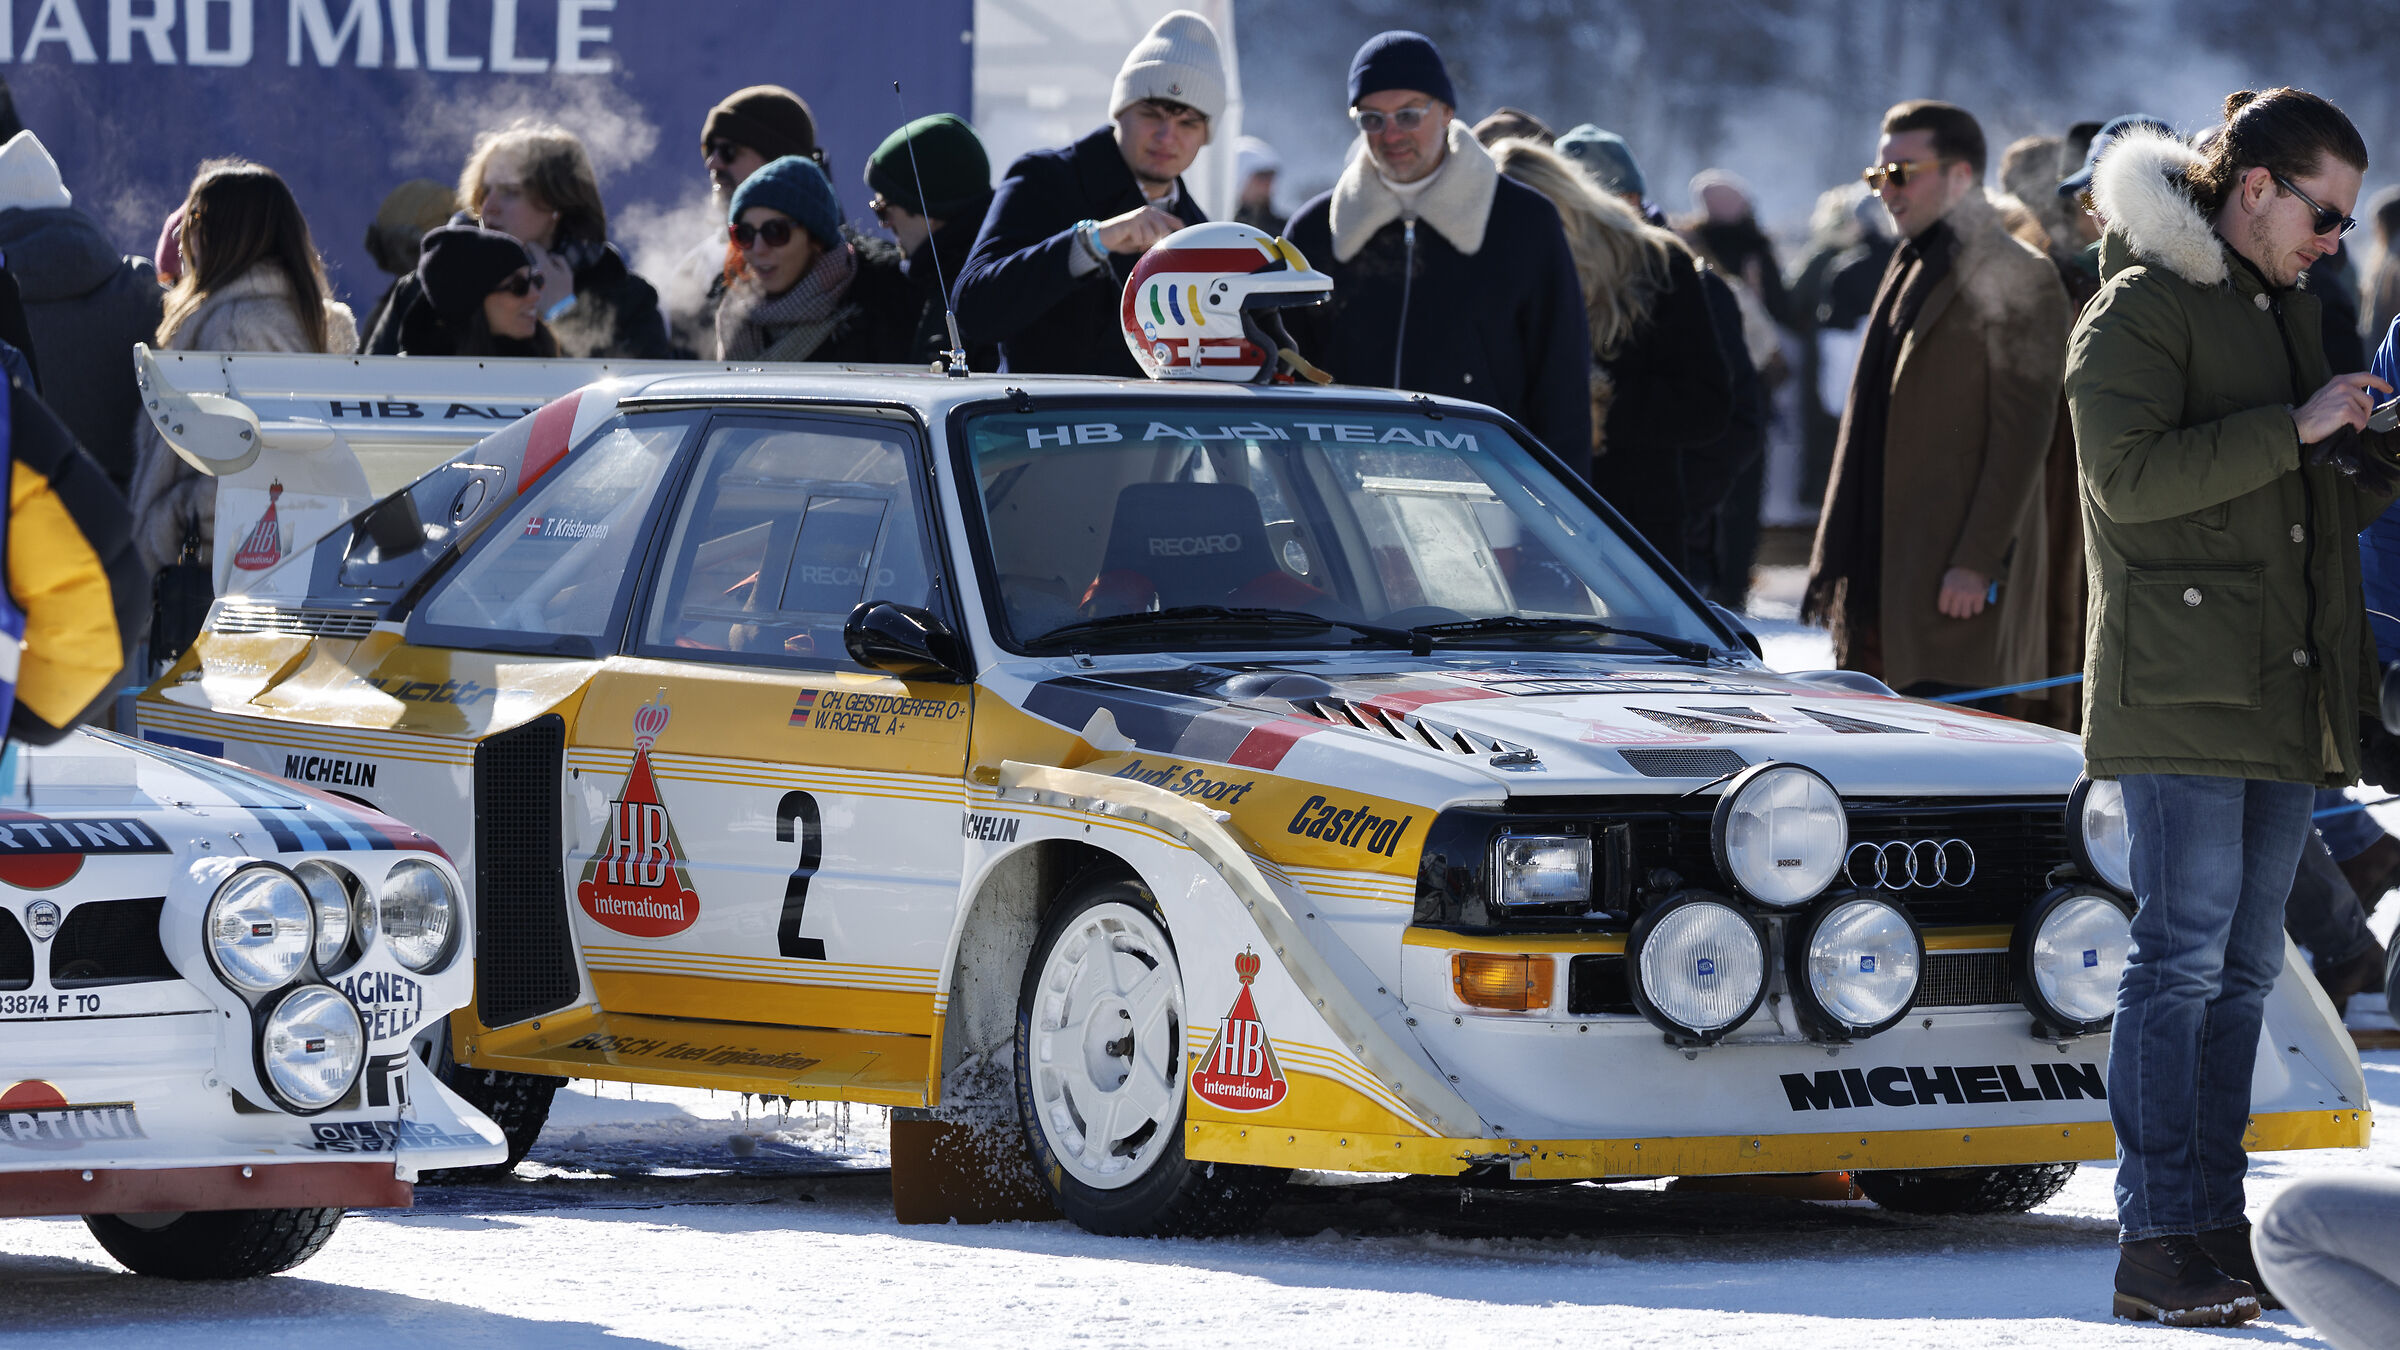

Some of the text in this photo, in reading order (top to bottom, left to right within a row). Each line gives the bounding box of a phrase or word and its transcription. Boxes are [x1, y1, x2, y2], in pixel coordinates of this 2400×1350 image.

[287, 0, 614, 73] MILLE
[329, 401, 424, 418] HB
[1026, 423, 1123, 448] HB
[1292, 422, 1479, 452] TEAM
[247, 520, 278, 553] HB
[544, 518, 609, 539] T. Kristensen
[1148, 533, 1242, 556] RECARO
[821, 691, 842, 709] CH.
[845, 693, 945, 718] GEISTDOERFER
[814, 711, 828, 729] W.
[829, 711, 881, 734] ROEHRL
[283, 754, 377, 788] MICHELIN
[1112, 760, 1255, 805] Audi Sport
[1287, 795, 1413, 858] Castrol
[607, 800, 671, 888] HB
[776, 790, 827, 960] 2
[1777, 859, 1802, 867] BOSCH
[594, 891, 685, 921] international
[0, 994, 101, 1014] 3874 F TO
[335, 971, 423, 1012] AGNETI
[360, 1007, 422, 1042] RELLI
[567, 1032, 666, 1056] BOSCH
[655, 1042, 726, 1061] fuel
[1217, 1017, 1264, 1078] HB
[1203, 1078, 1274, 1101] international
[1779, 1063, 2108, 1111] MICHELIN
